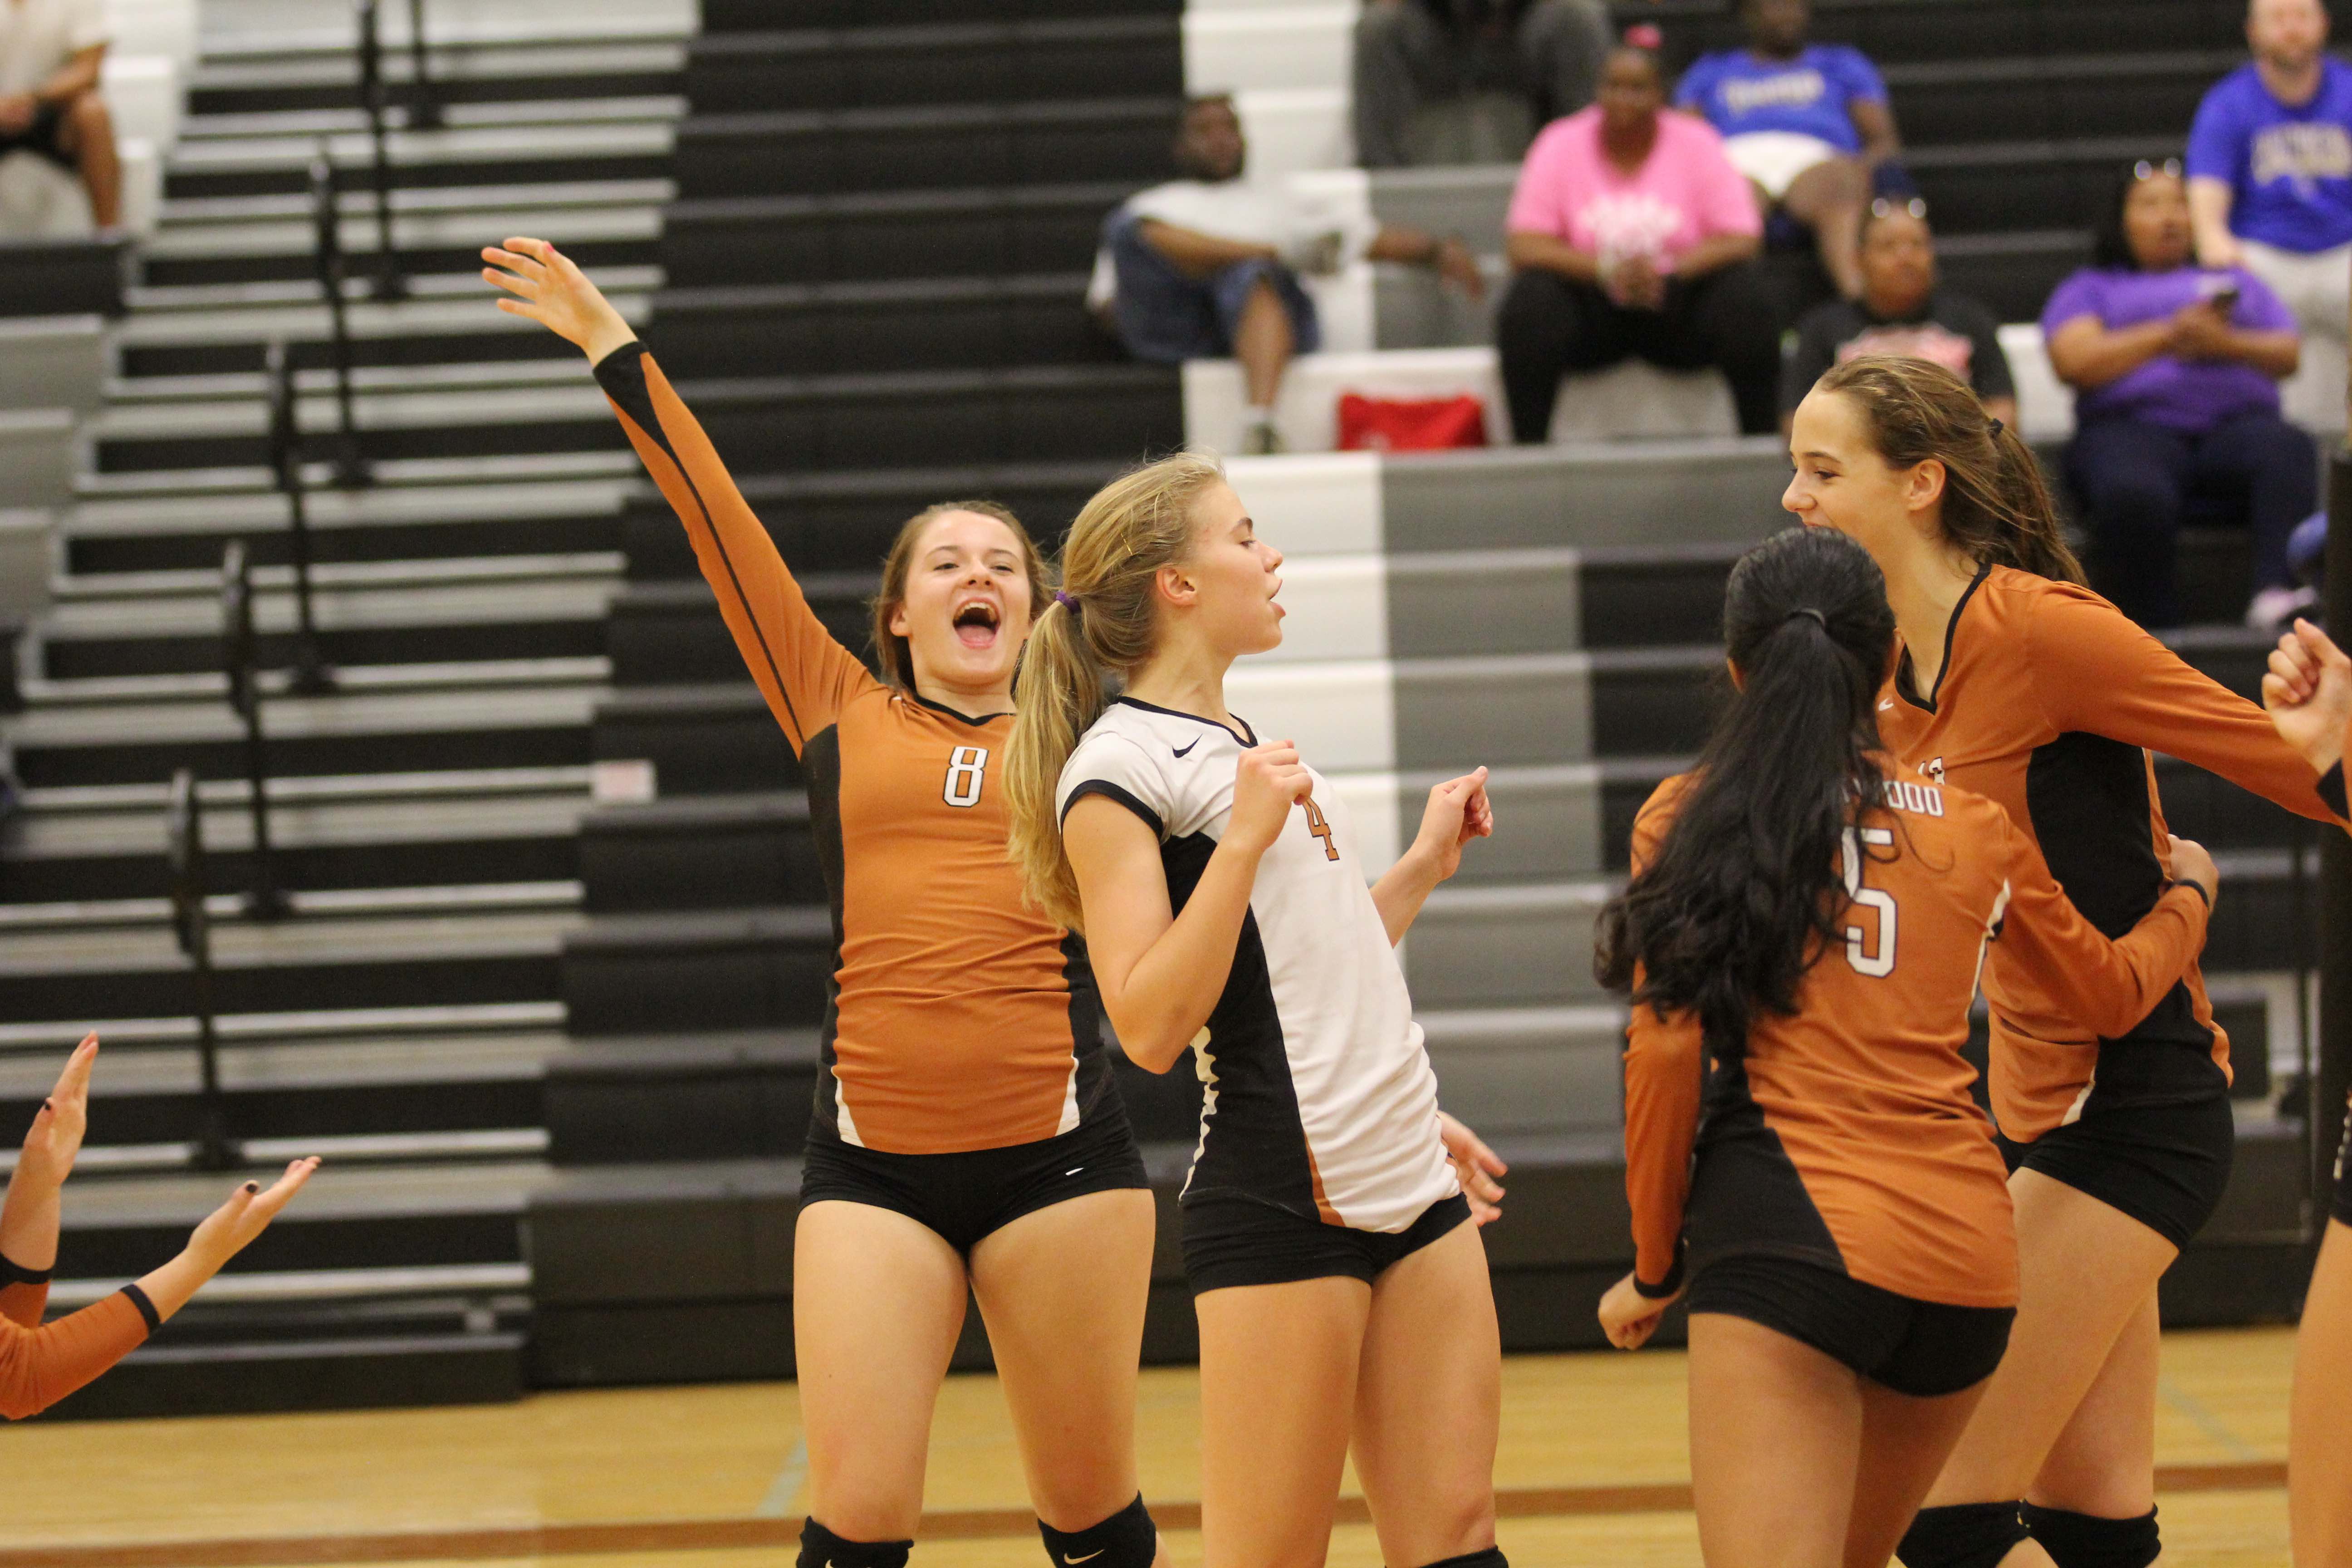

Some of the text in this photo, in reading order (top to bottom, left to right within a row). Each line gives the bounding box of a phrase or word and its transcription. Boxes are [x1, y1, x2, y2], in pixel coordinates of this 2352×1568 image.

[943, 746, 989, 808] 8
[1303, 797, 1339, 861] 4
[1842, 826, 1898, 978] 5
